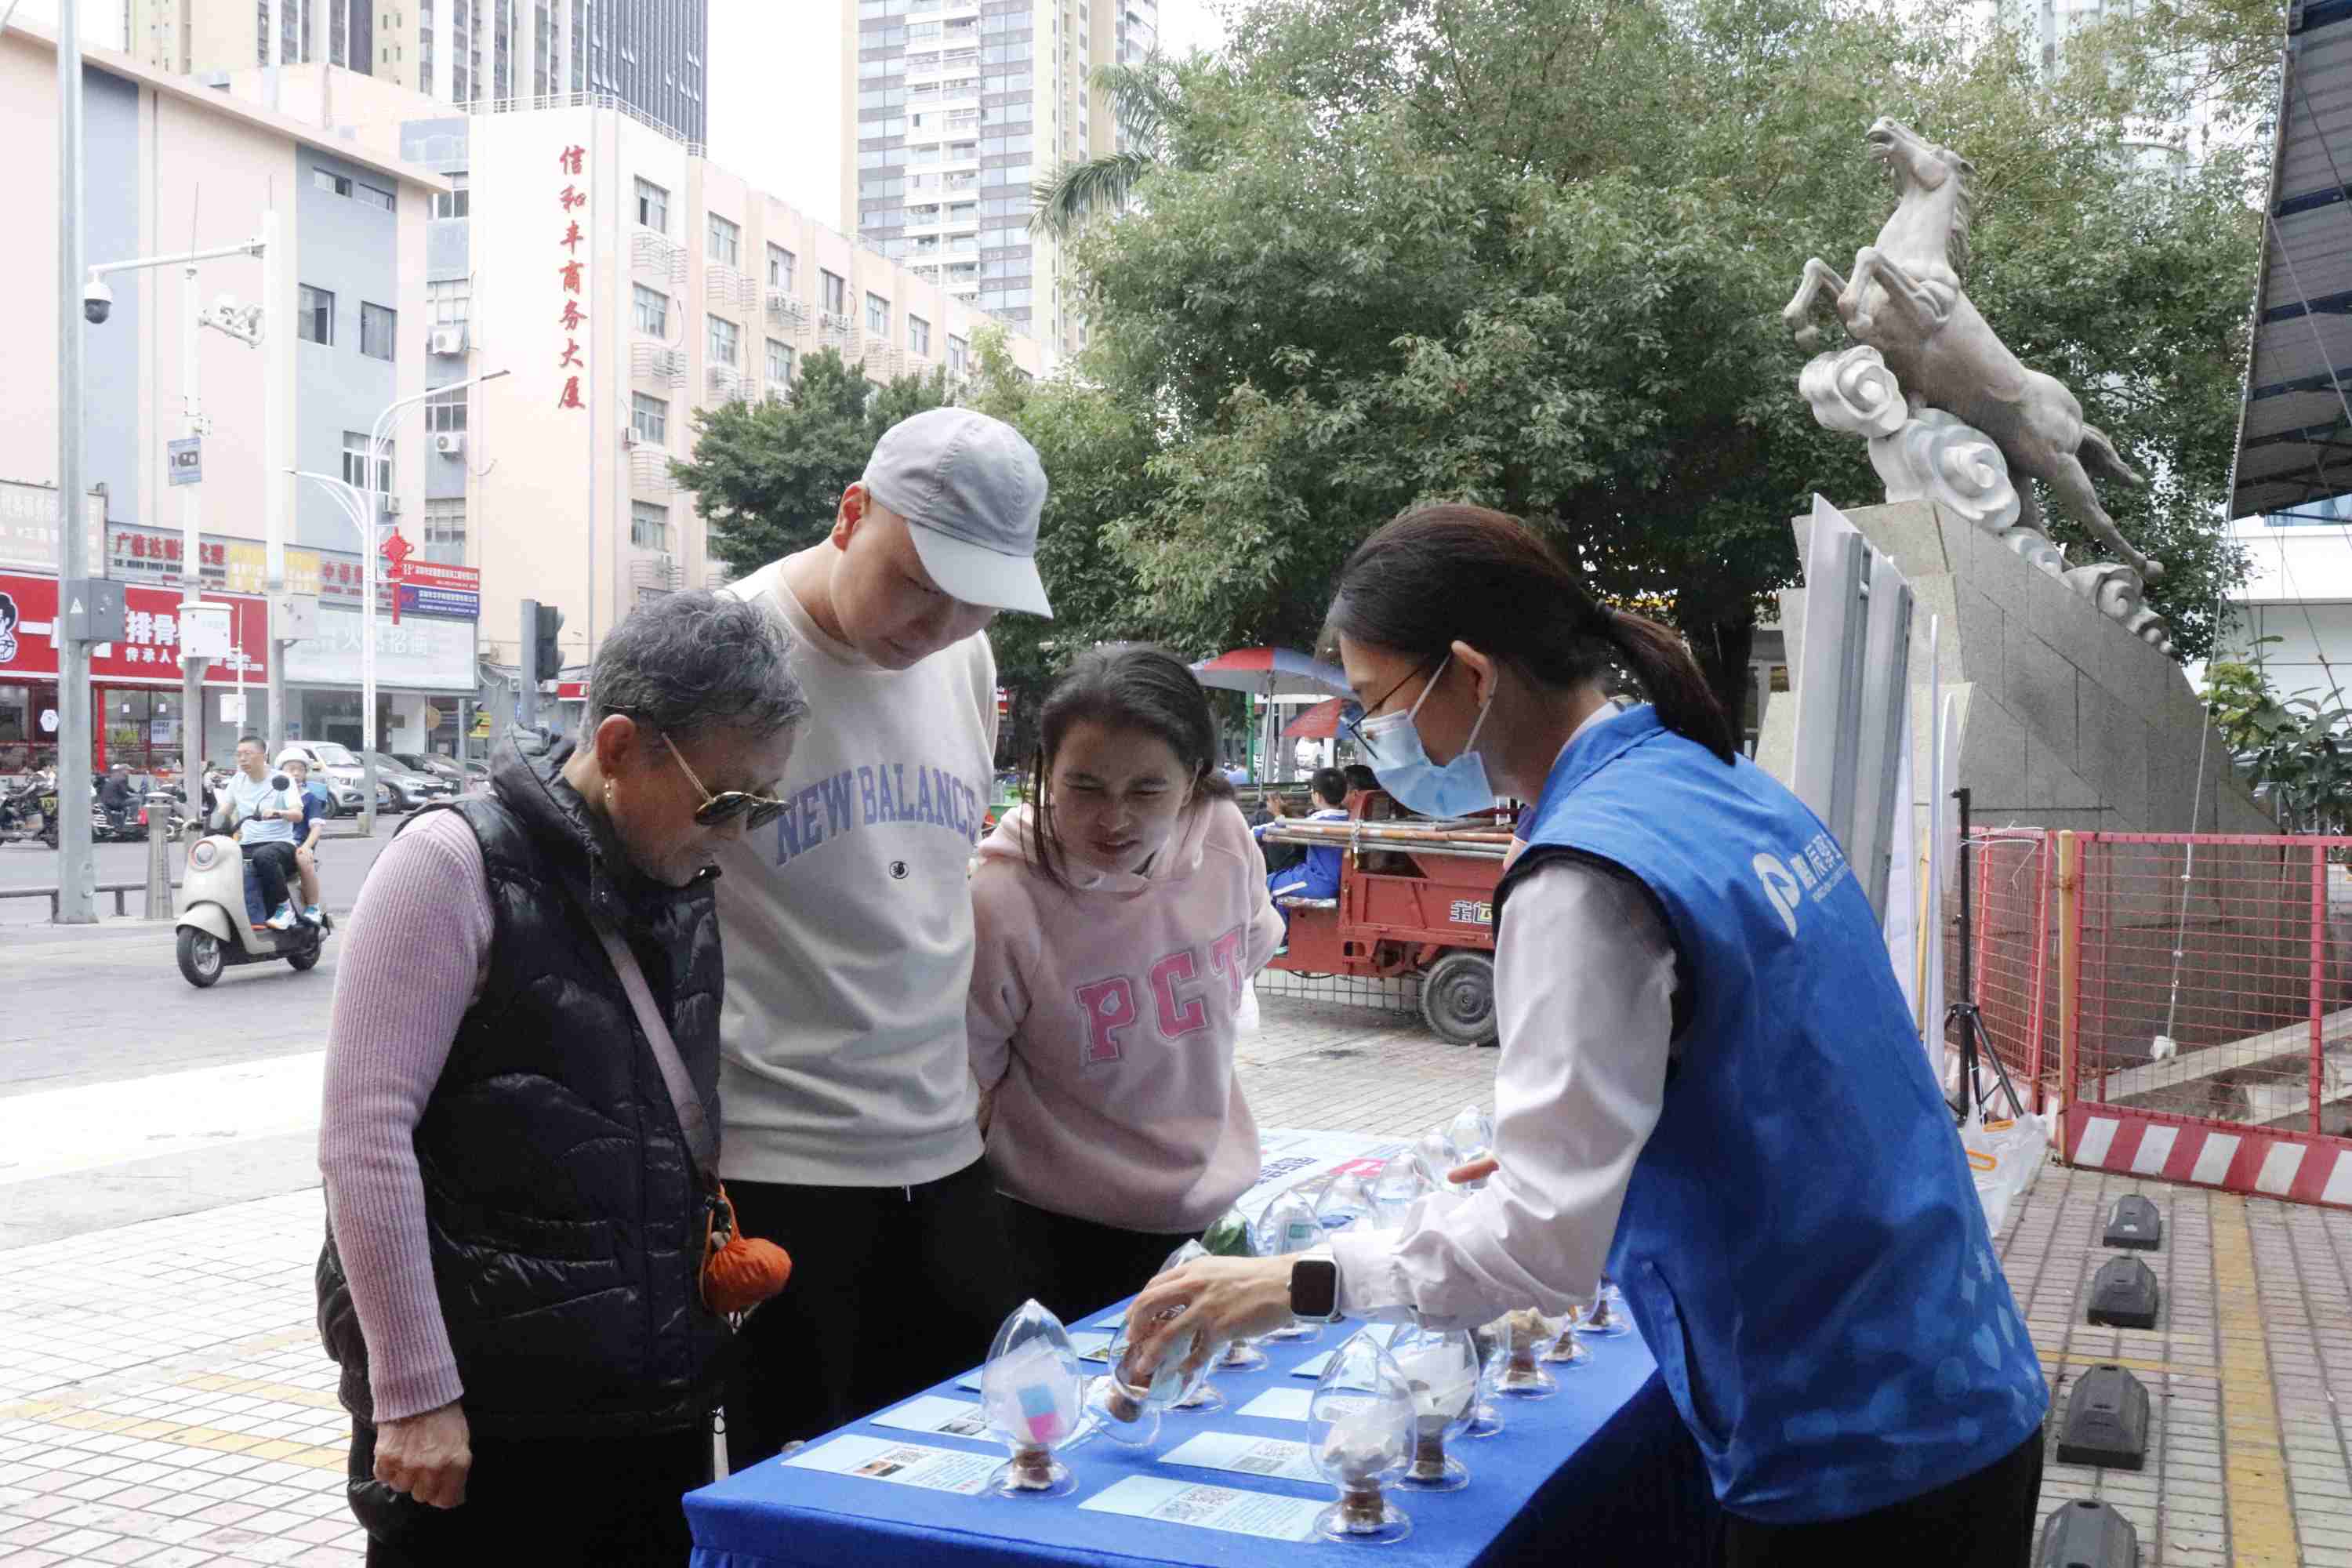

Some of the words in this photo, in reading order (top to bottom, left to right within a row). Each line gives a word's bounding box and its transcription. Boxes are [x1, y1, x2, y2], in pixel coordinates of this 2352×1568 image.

[557, 144, 587, 410] 信和丰商务大厦
[776, 770, 852, 866] NEW
[858, 764, 978, 847] BALANCE
[1073, 925, 1245, 1062] PCT
